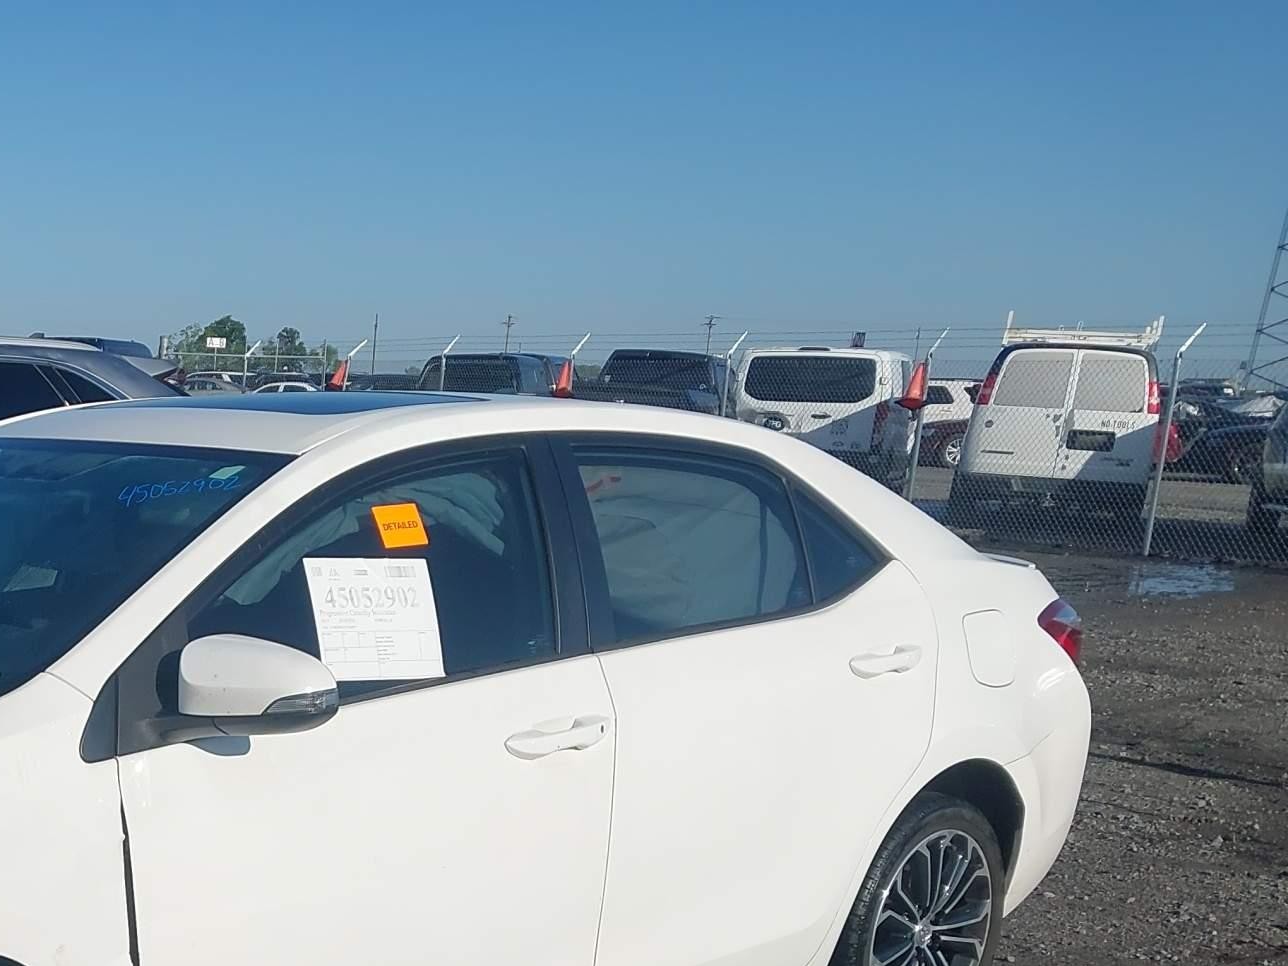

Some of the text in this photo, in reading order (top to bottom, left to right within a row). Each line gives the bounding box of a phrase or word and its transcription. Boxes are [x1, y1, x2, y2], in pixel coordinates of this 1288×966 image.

[118, 475, 241, 507] 45052902
[383, 520, 418, 531] DETAILED
[325, 586, 420, 609] 45052902
